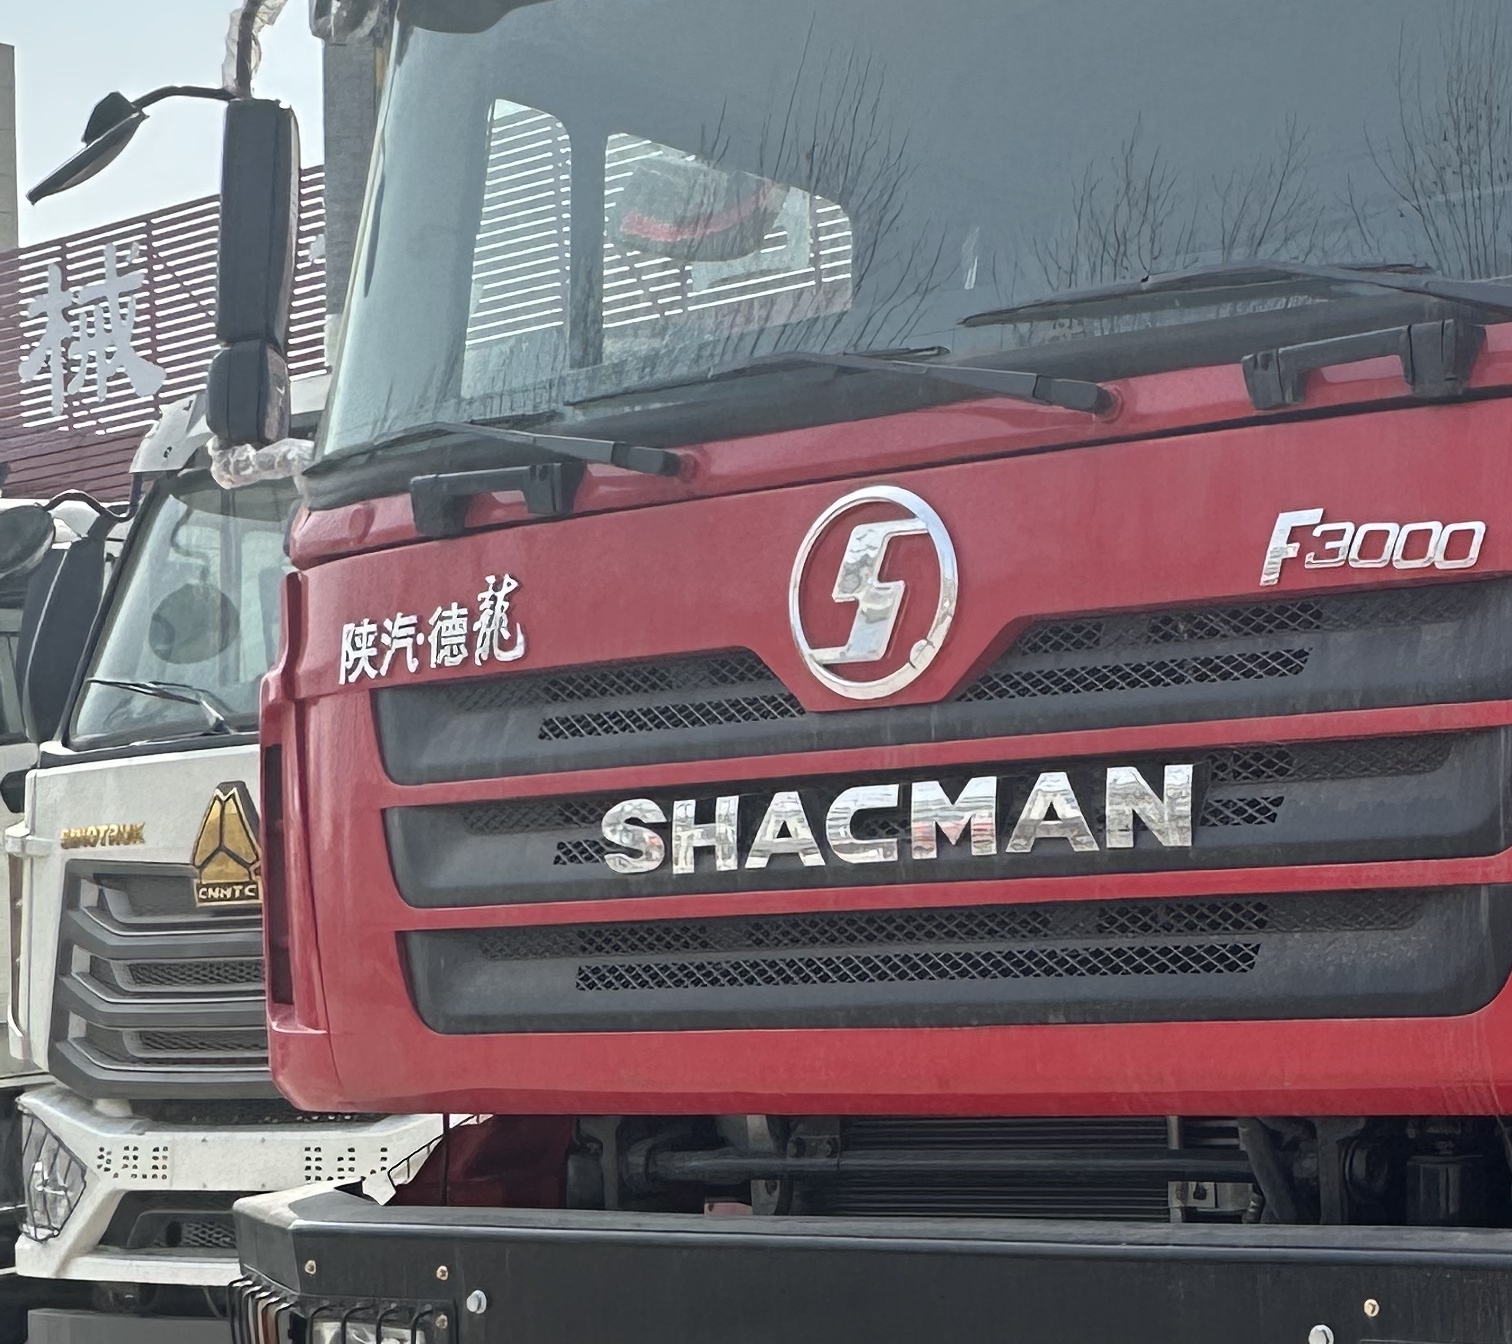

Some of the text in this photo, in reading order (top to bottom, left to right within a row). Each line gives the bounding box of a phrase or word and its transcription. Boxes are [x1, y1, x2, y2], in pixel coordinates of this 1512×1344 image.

[18, 241, 166, 416] 械
[1260, 508, 1486, 586] F3000
[600, 763, 1194, 875] SHACMAN
